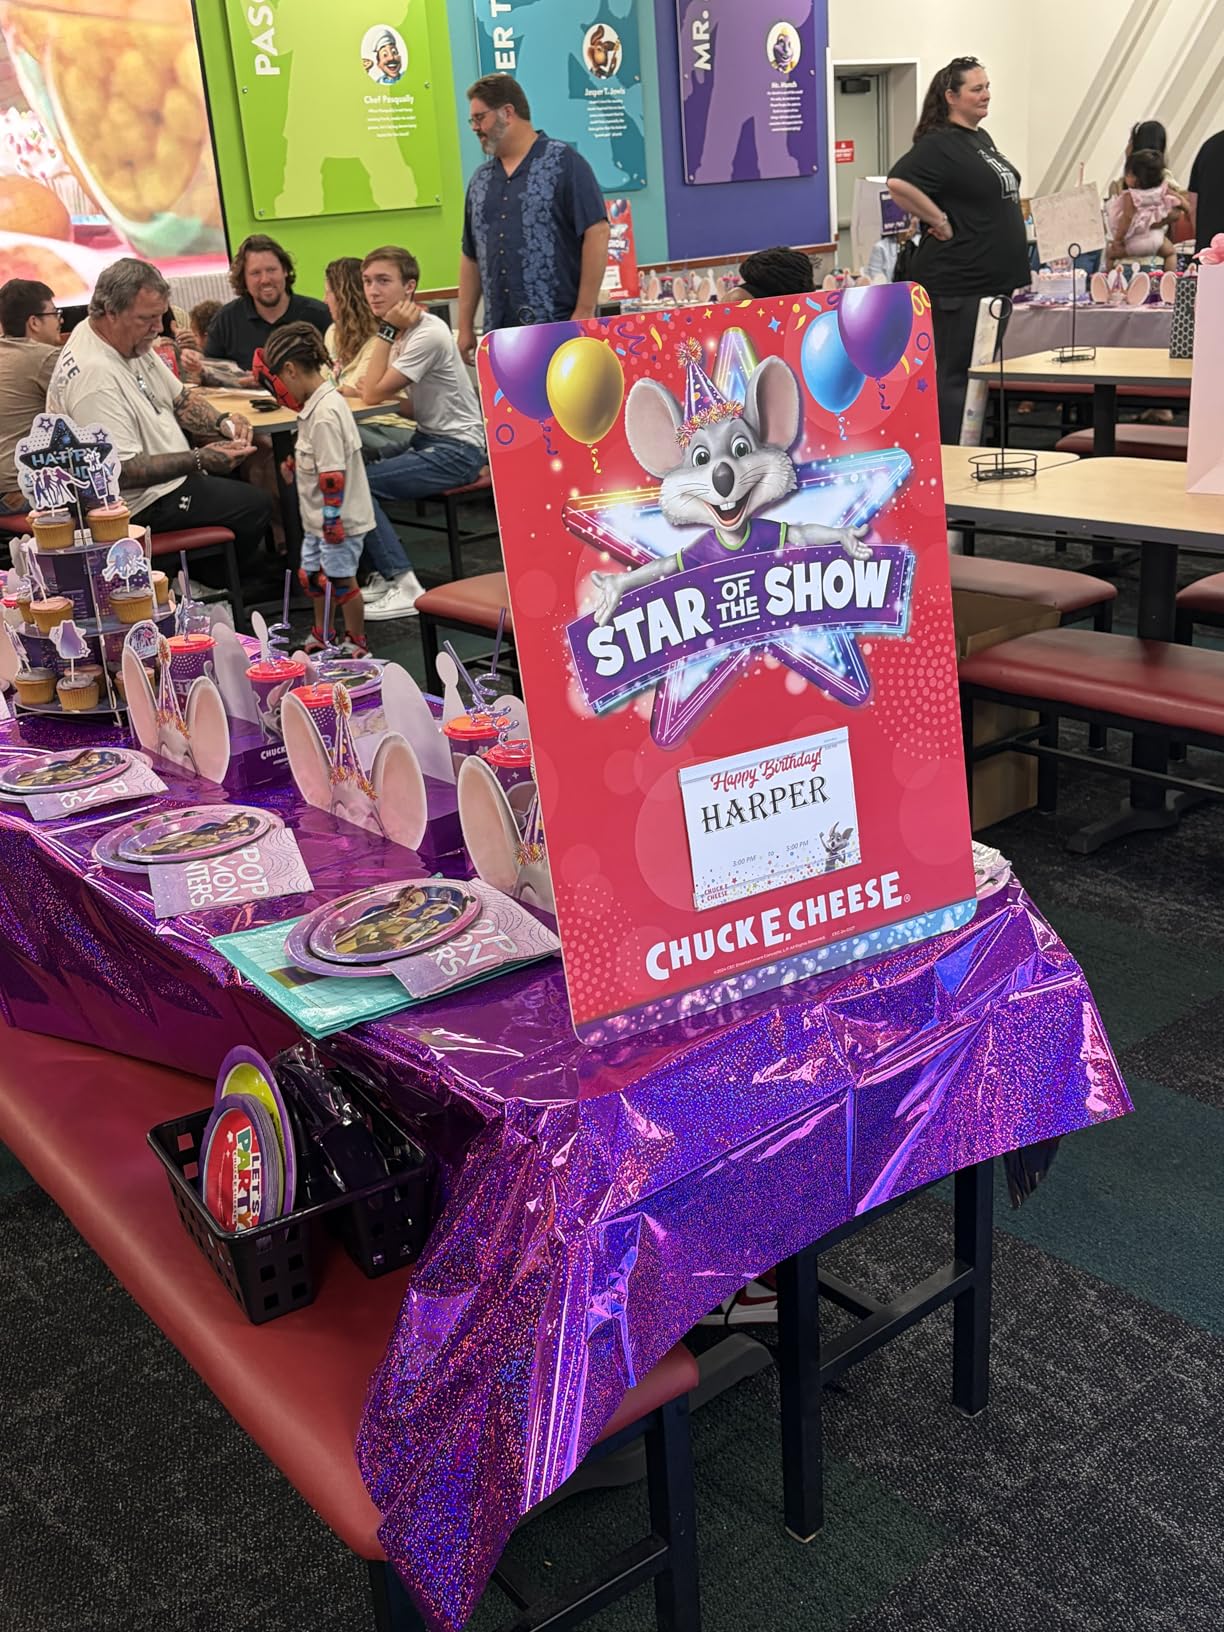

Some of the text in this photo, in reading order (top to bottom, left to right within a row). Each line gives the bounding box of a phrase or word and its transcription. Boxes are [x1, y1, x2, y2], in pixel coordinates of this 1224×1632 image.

[248, 0, 281, 76] PAS
[692, 10, 712, 71] MR.
[363, 94, 414, 105] Chef Pasqually
[587, 558, 892, 677] STAR OF THE SHOW
[710, 747, 823, 793] Happy Birthday!
[701, 776, 831, 834] HARPER
[645, 871, 903, 981] CHUCK E. CHEESE
[707, 890, 729, 901] CHEESE
[251, 1152, 262, 1218] LET'S
